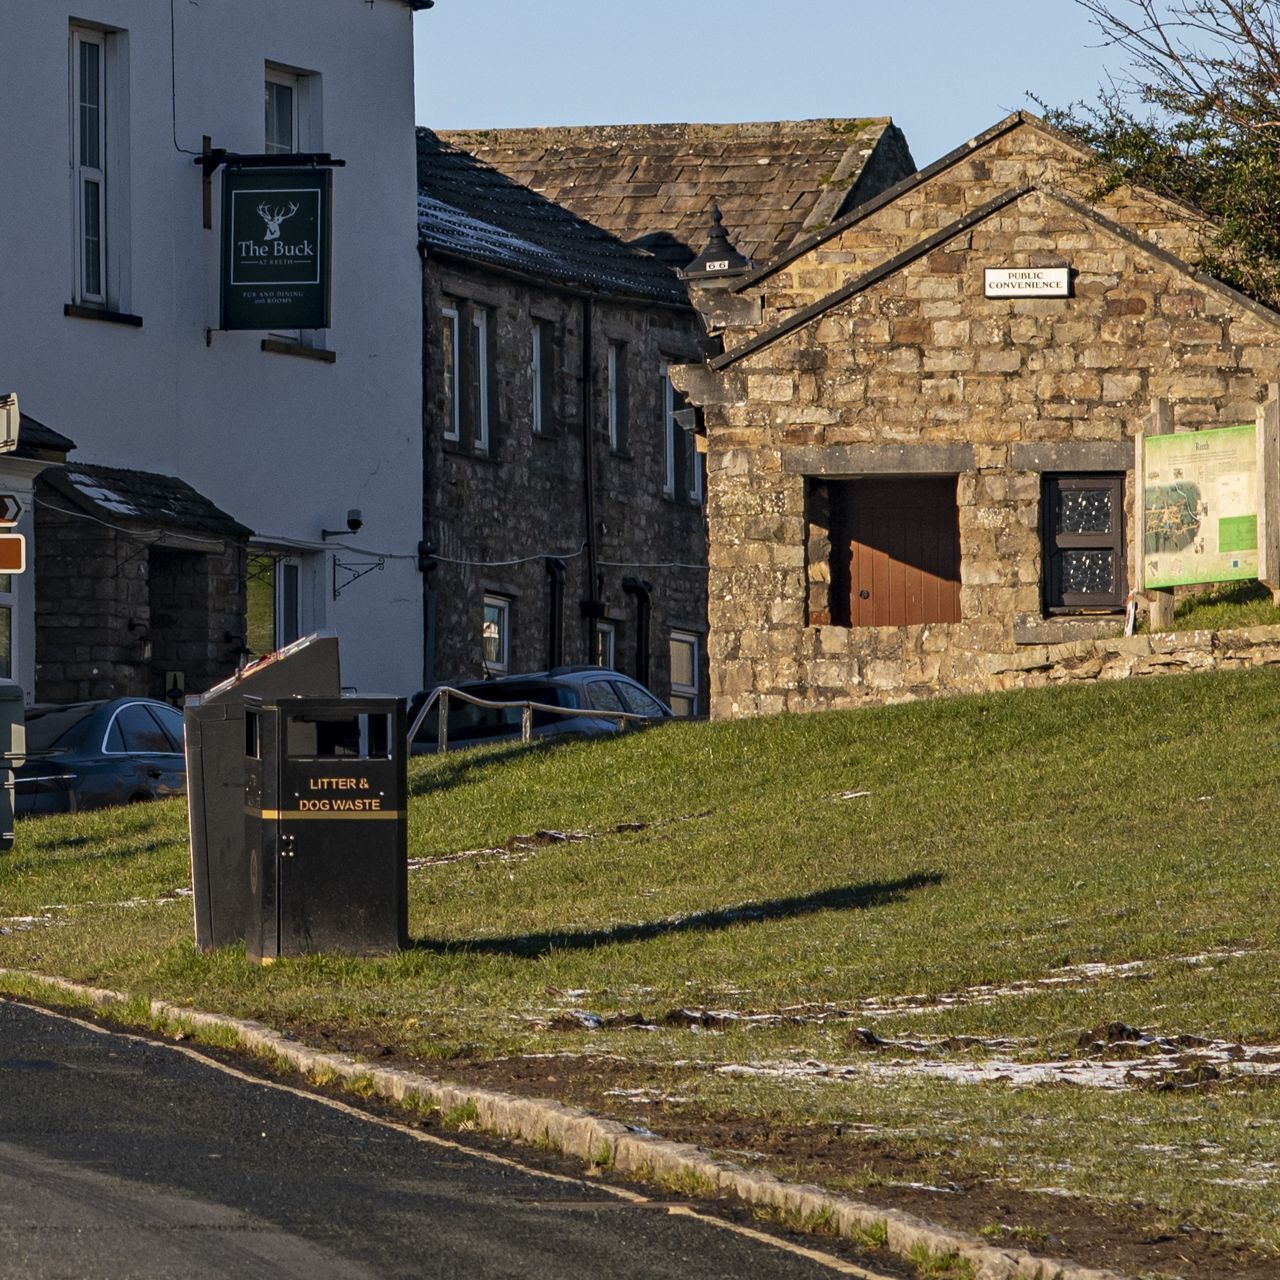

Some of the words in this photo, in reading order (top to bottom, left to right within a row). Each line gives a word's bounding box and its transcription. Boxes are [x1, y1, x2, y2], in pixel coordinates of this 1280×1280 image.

[238, 240, 269, 256] The
[274, 240, 314, 256] Buck
[1008, 272, 1044, 280] PUBLIC
[989, 281, 1063, 289] CONVENIENCE
[310, 778, 356, 789] LITTER
[359, 778, 369, 789] &
[300, 800, 330, 810] DOG
[332, 799, 381, 810] WASTE
